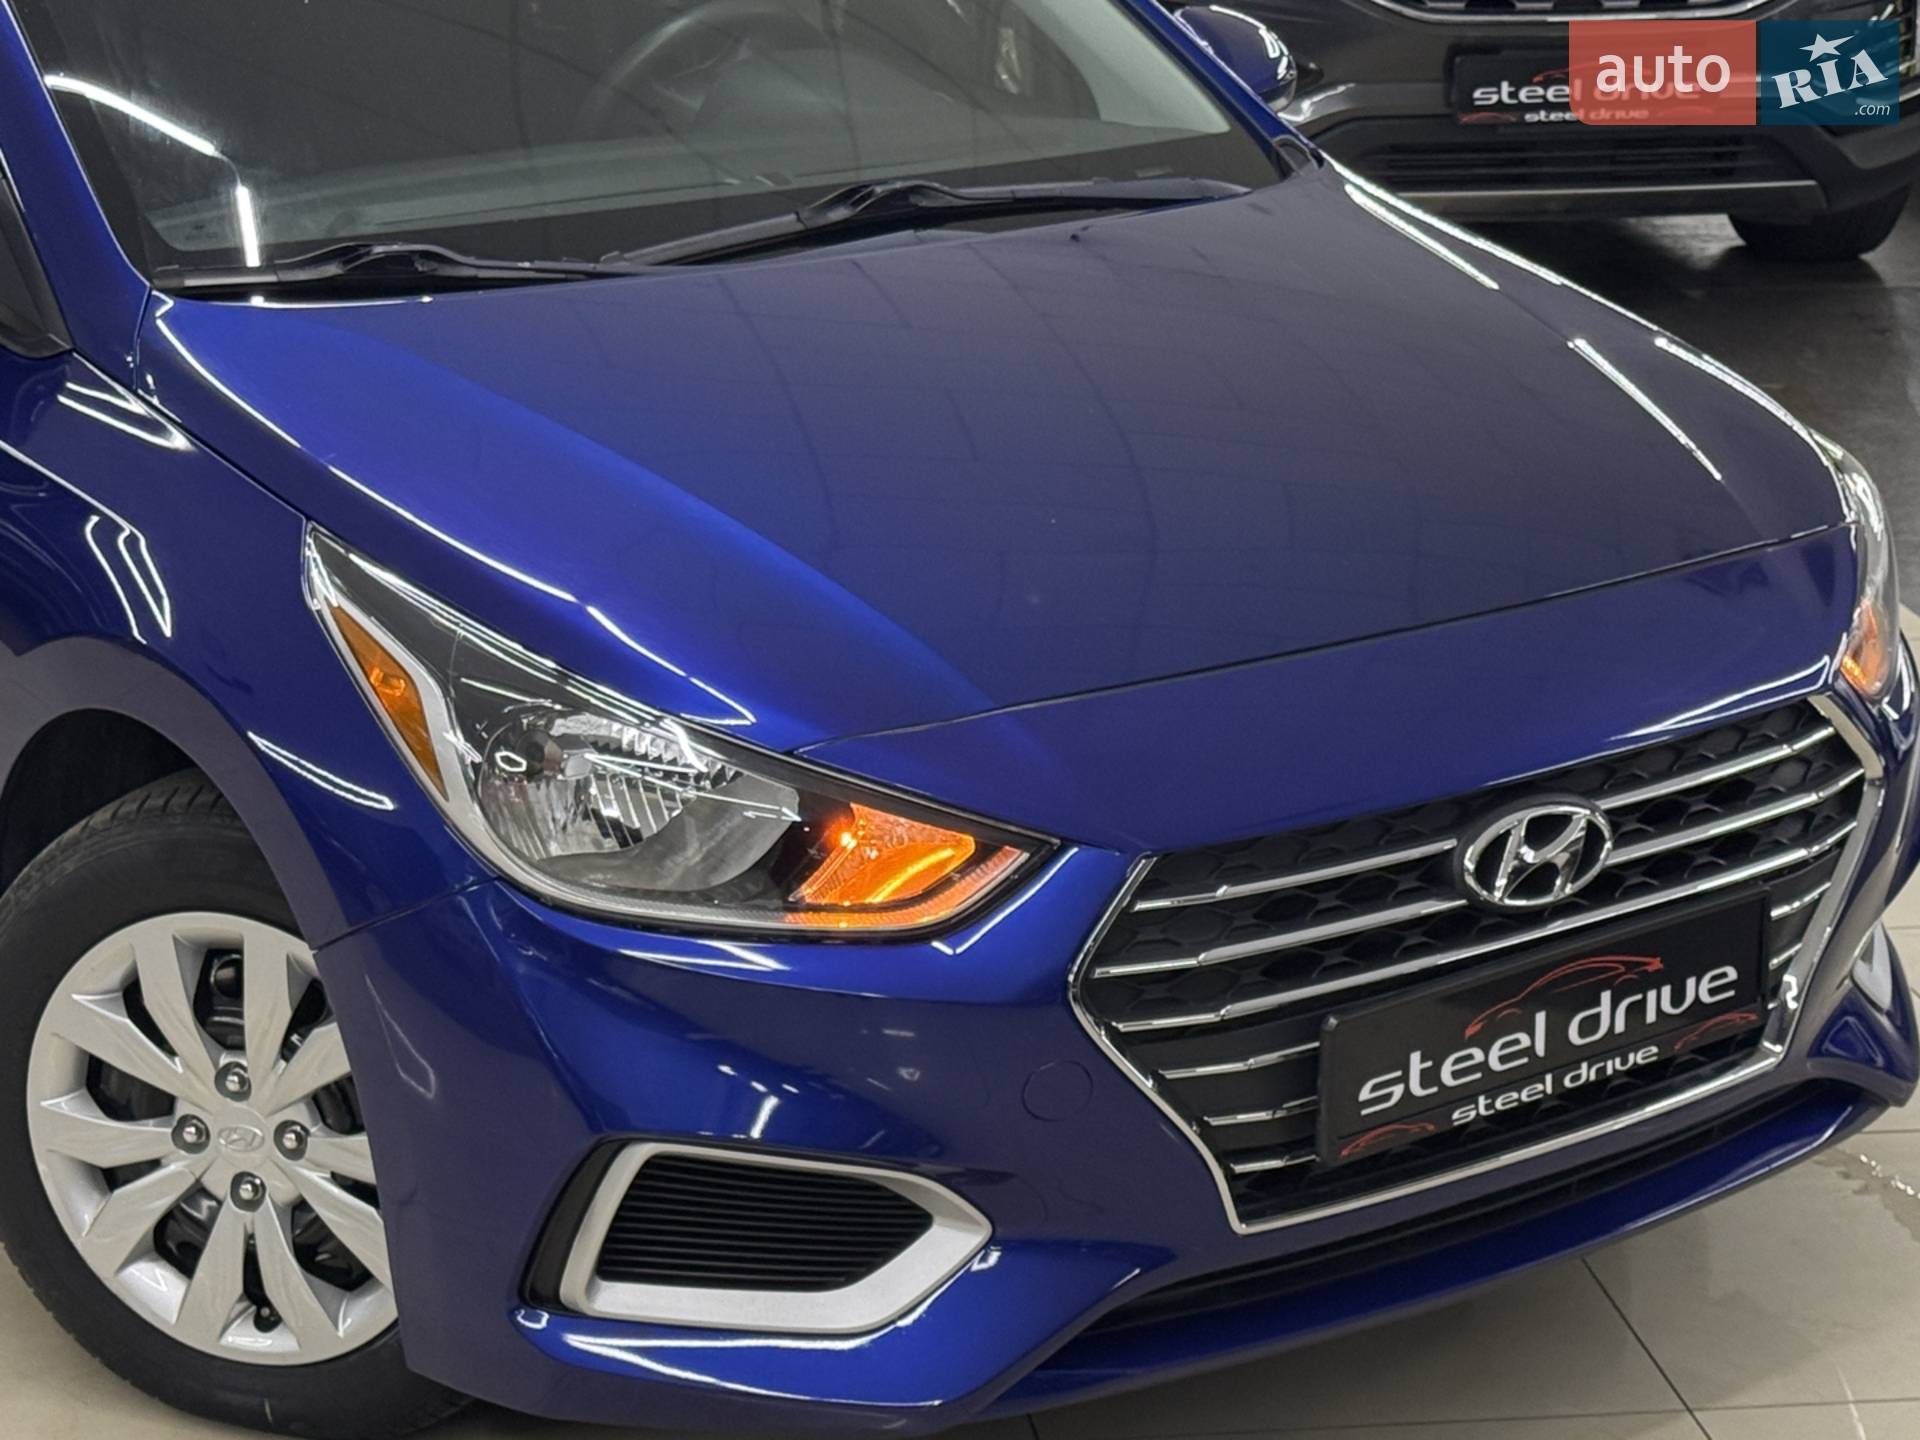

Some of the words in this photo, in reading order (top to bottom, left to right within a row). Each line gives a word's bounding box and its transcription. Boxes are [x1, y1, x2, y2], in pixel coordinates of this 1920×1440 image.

[1358, 1010, 1547, 1117] steel
[1567, 965, 1739, 1047] drive
[1451, 1073, 1554, 1127] steel
[1562, 1044, 1660, 1089] drive
